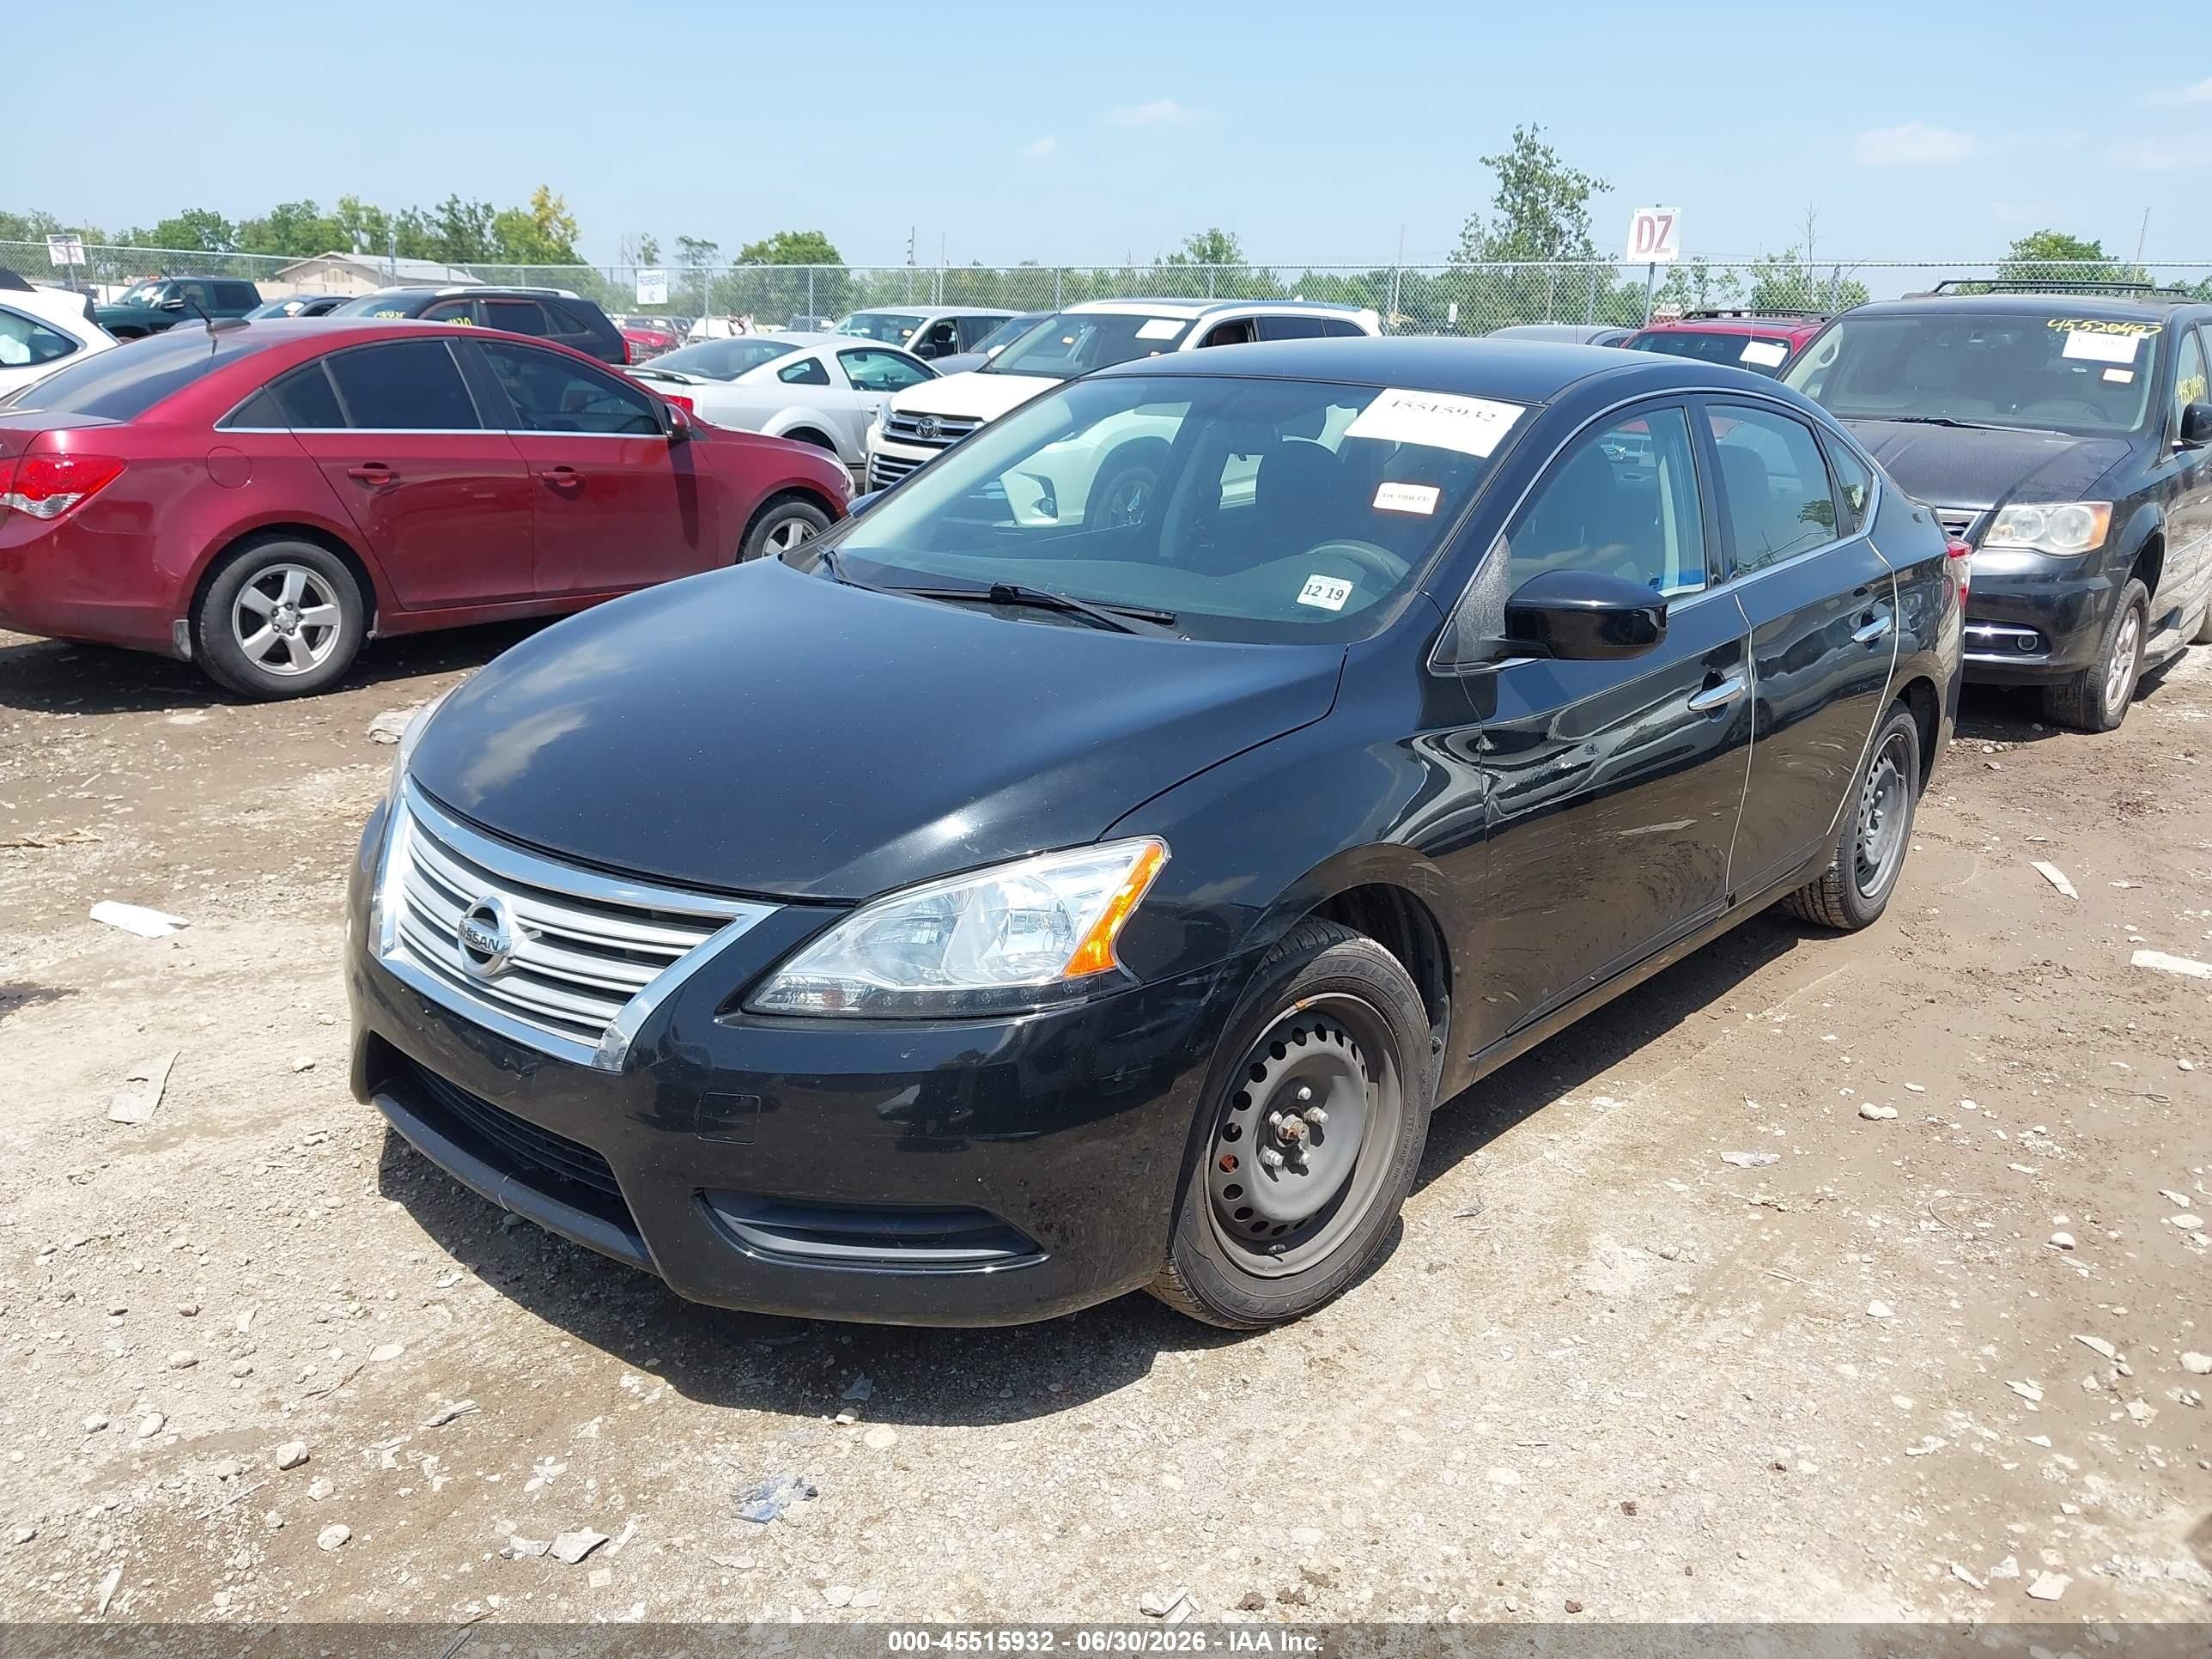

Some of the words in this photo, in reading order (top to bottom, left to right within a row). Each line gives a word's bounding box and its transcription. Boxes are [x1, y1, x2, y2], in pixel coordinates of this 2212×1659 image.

[1304, 584, 1322, 597] 12
[1325, 587, 1345, 601] 19
[458, 920, 500, 951] NISSAN
